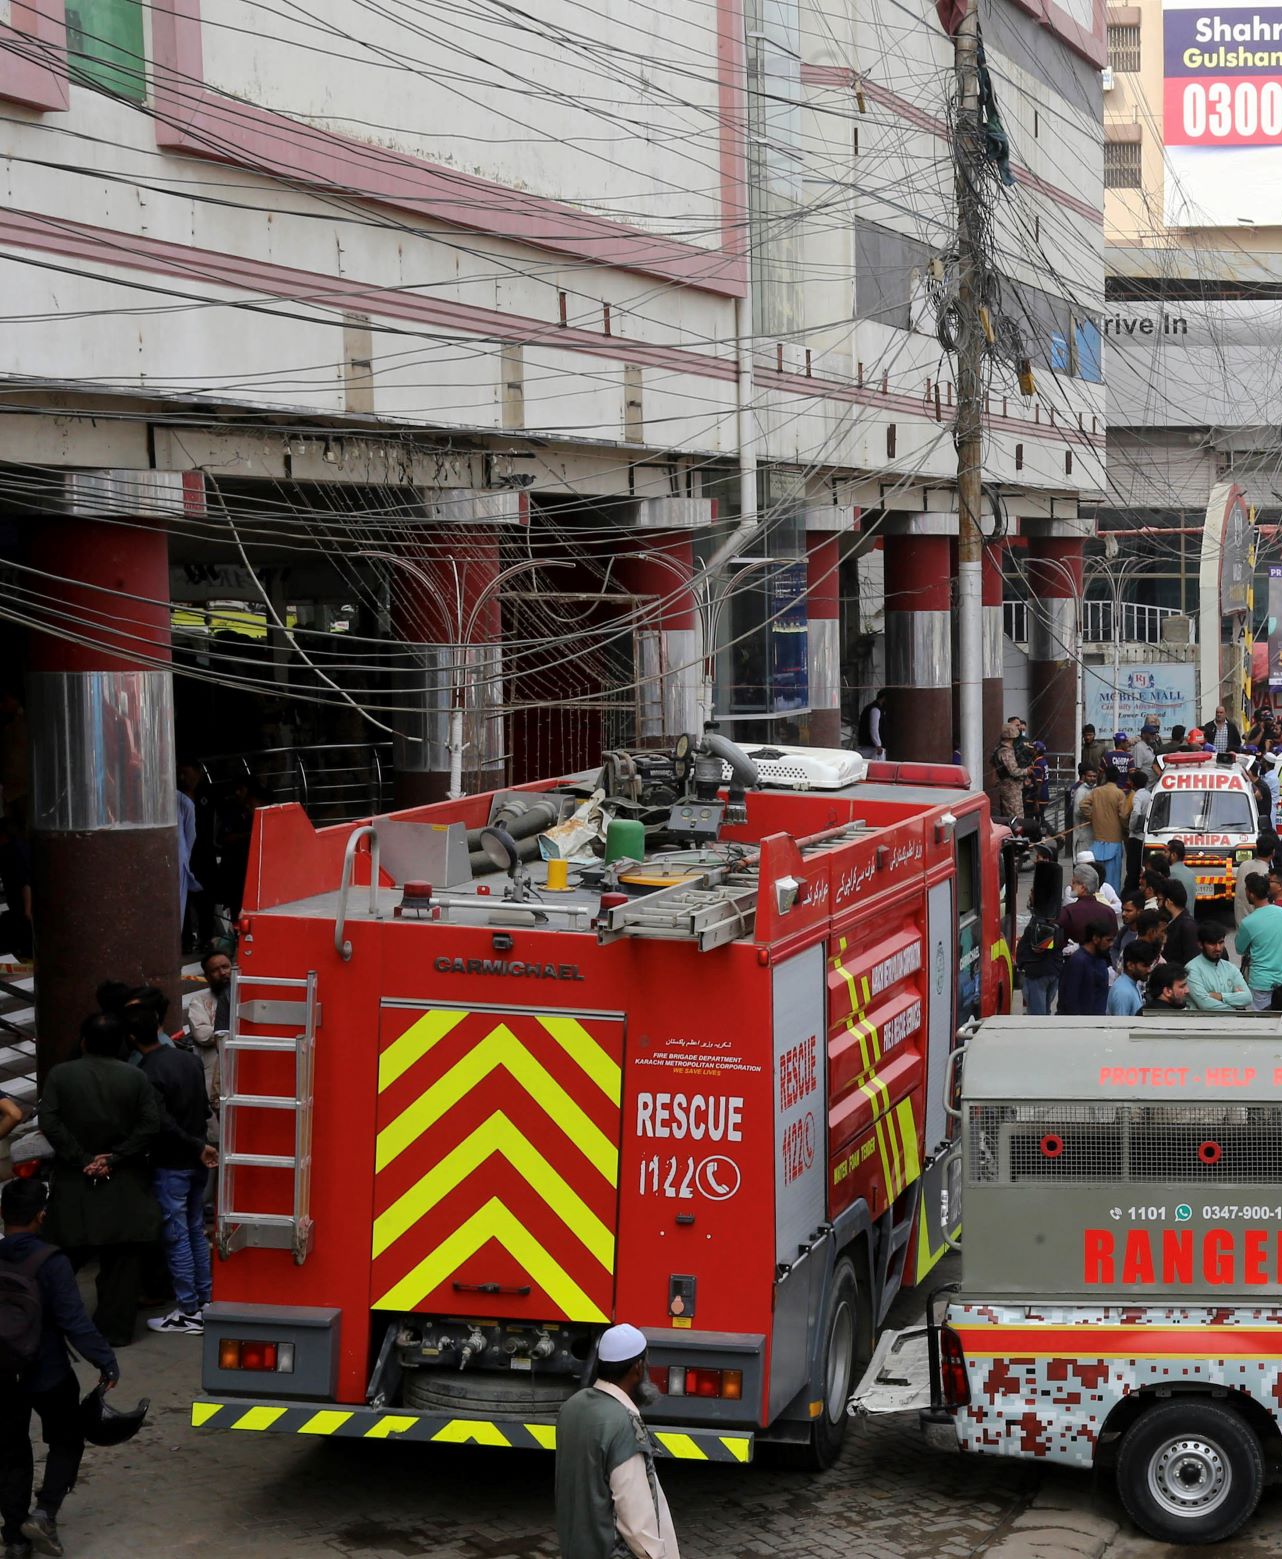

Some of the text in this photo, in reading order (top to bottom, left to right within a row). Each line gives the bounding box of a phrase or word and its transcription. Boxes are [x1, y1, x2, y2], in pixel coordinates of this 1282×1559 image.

[1105, 312, 1188, 335] rive In
[1150, 691, 1184, 701] MALL
[1161, 775, 1243, 790] CHHIPA
[434, 956, 585, 981] CARMICHAEL
[635, 1058, 762, 1072] KARACHI METROPOLITAN CORPORATION
[669, 1053, 698, 1061] BRIGADE
[698, 1055, 742, 1063] DEPARTMENT
[702, 1069, 721, 1077] LIVES
[780, 1035, 816, 1113] RESCUE
[1099, 1066, 1190, 1087] PROTECT
[1205, 1067, 1256, 1087] HELP
[636, 1092, 744, 1142] RESCUE
[782, 1118, 804, 1188] 1122
[1127, 1206, 1166, 1220] 1101
